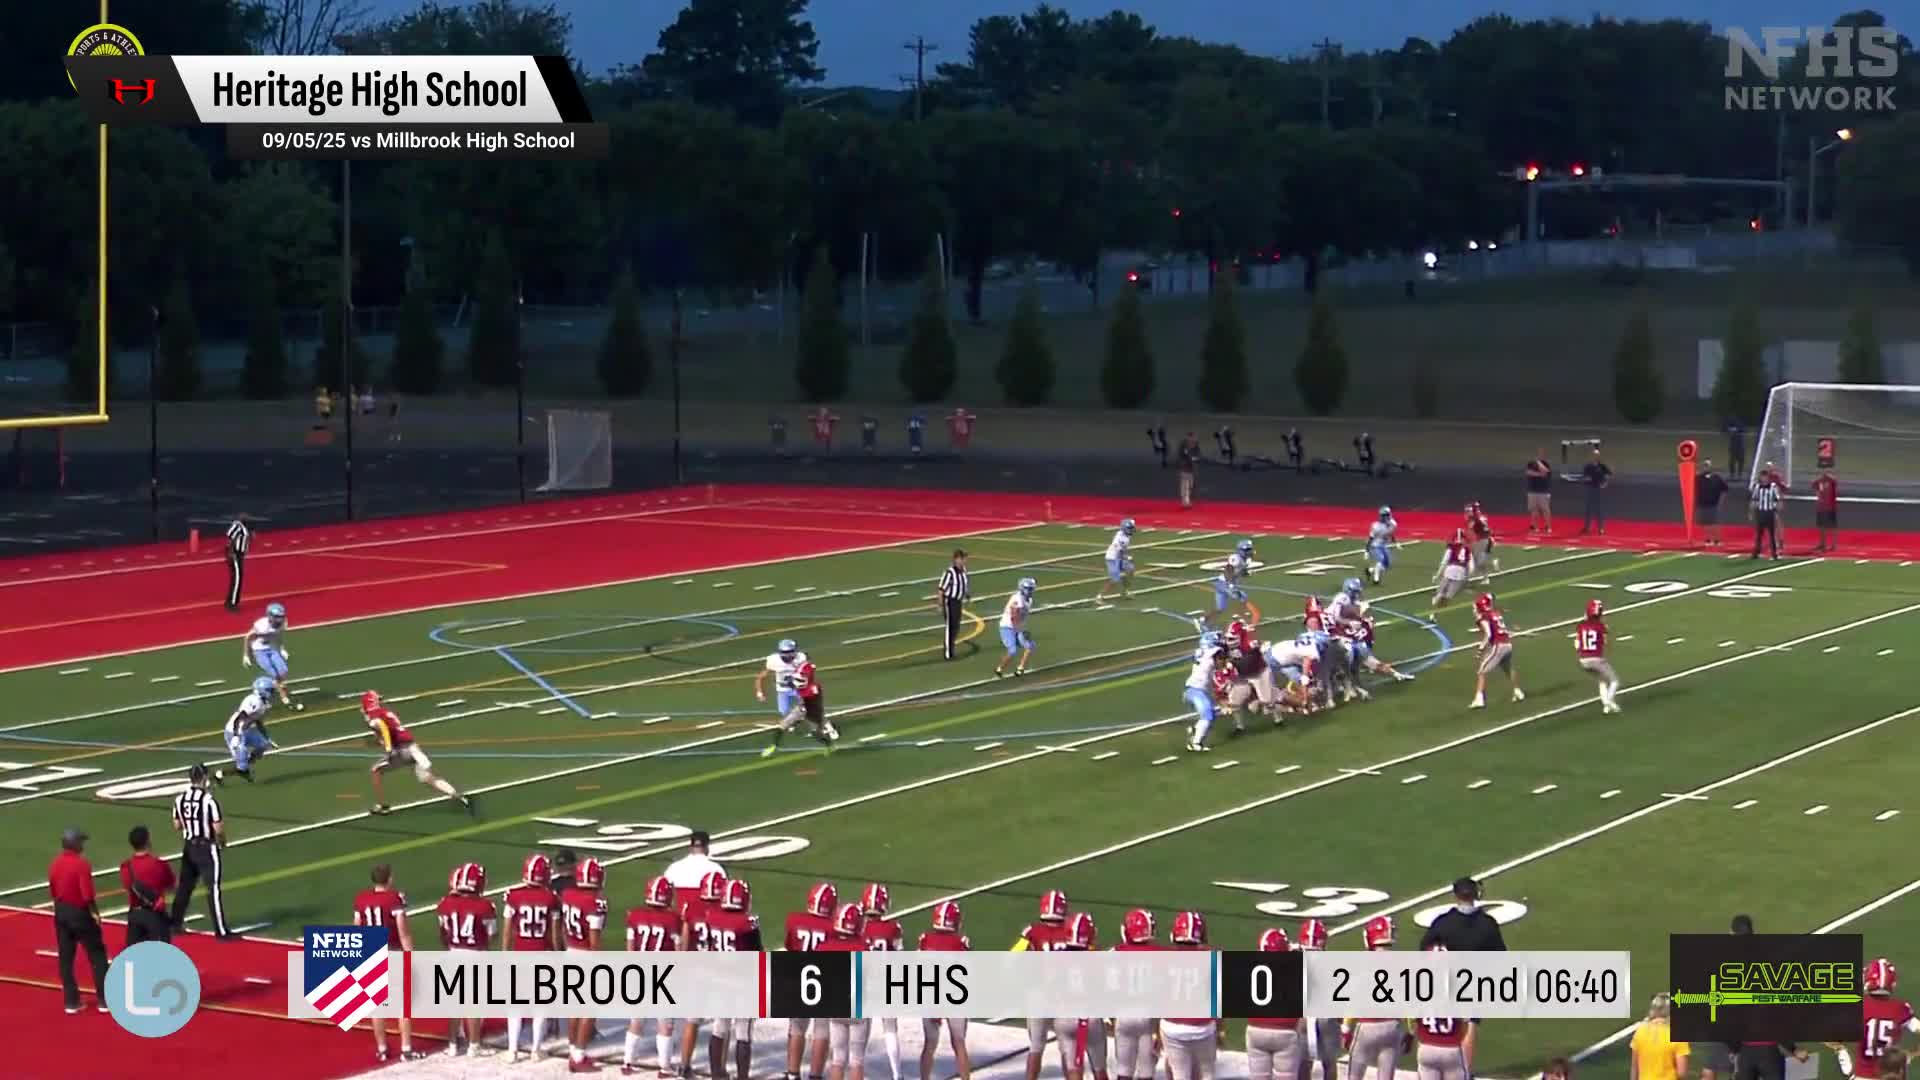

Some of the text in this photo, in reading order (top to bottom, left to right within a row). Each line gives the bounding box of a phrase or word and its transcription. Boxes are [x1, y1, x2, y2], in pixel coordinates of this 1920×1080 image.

[1817, 437, 1834, 459] 2
[1582, 630, 1597, 650] 12
[183, 802, 201, 819] 37
[451, 911, 475, 944] 14
[519, 904, 548, 938] 25
[637, 924, 665, 951] 77
[1865, 1018, 1894, 1056] 15
